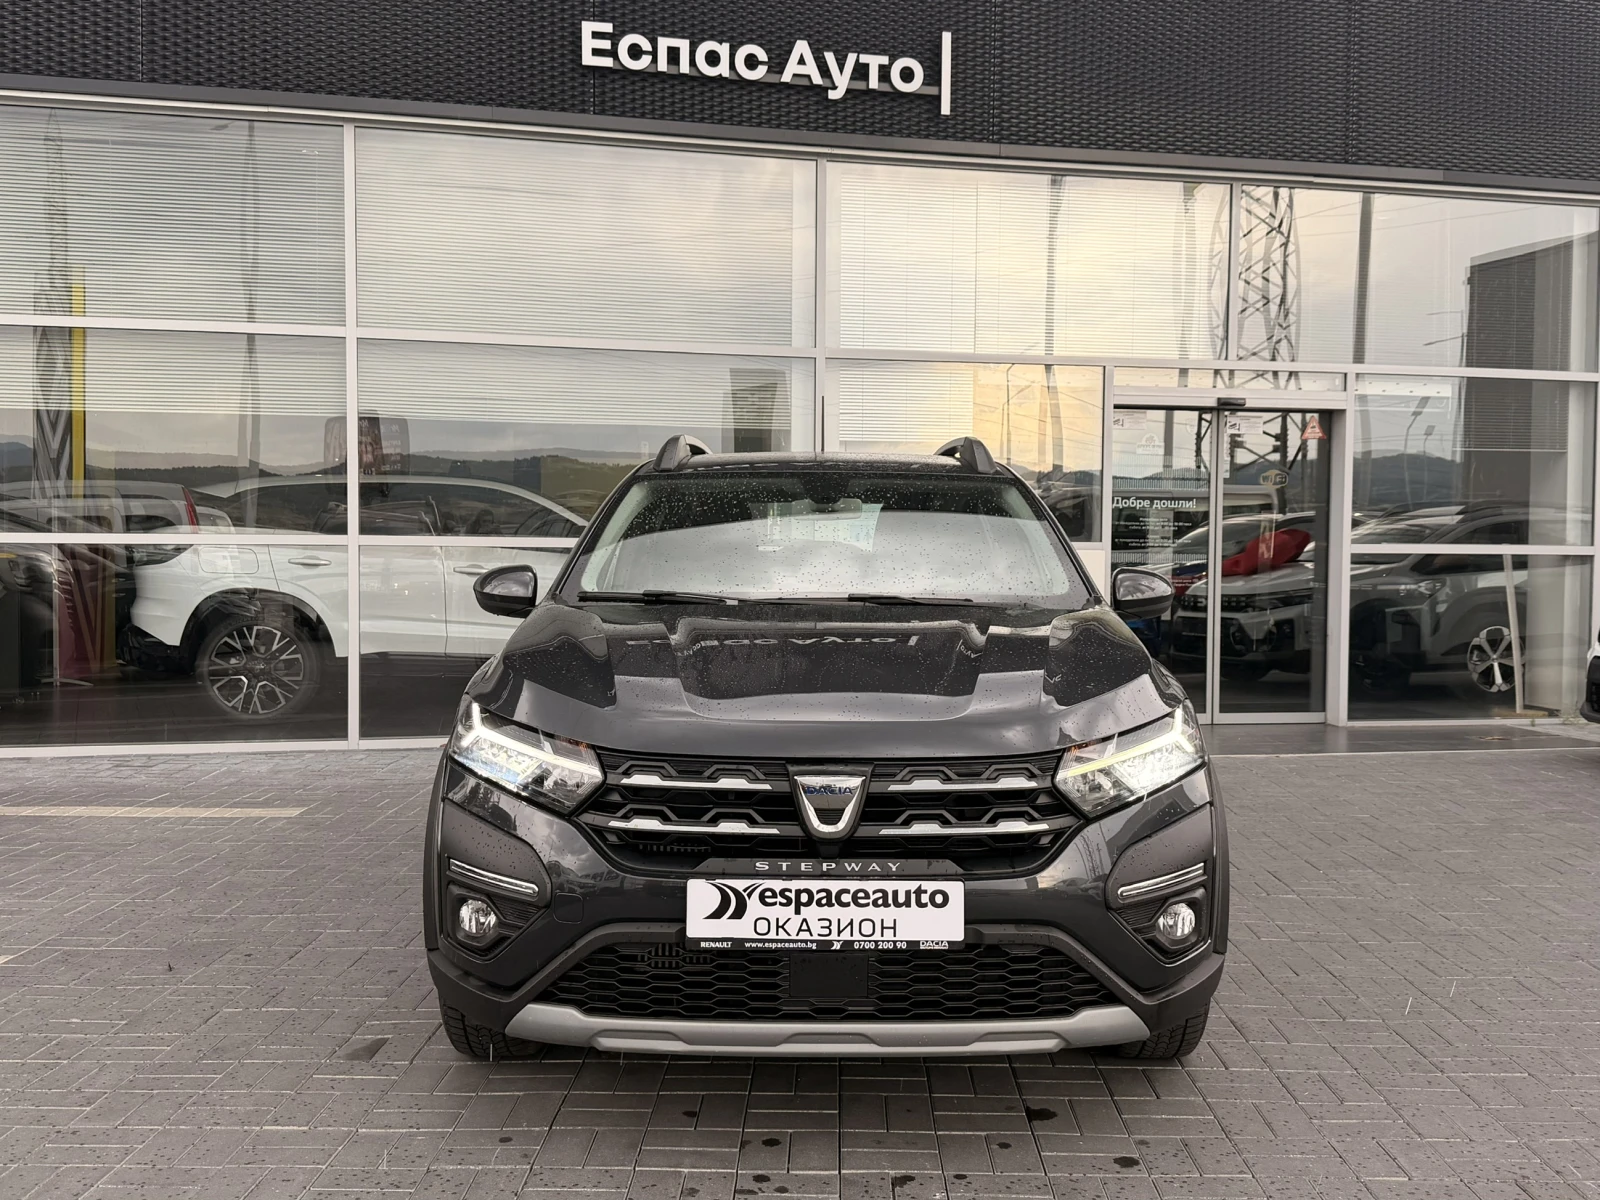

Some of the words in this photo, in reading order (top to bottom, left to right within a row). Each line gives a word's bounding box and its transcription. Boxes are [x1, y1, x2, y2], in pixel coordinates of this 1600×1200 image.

[581, 20, 769, 81] Еспас
[780, 39, 925, 100] Ауто
[1112, 496, 1151, 510] Добре
[1152, 498, 1197, 510] дошли!
[806, 786, 853, 795] DACIA
[755, 861, 902, 873] STEPWAY
[758, 883, 950, 916] espaceauto
[753, 917, 898, 938] ОКАЗИОН
[744, 941, 817, 950] www.espaceauto.bg
[853, 941, 877, 949] 0700
[878, 941, 894, 949] 200
[896, 941, 907, 949] 90
